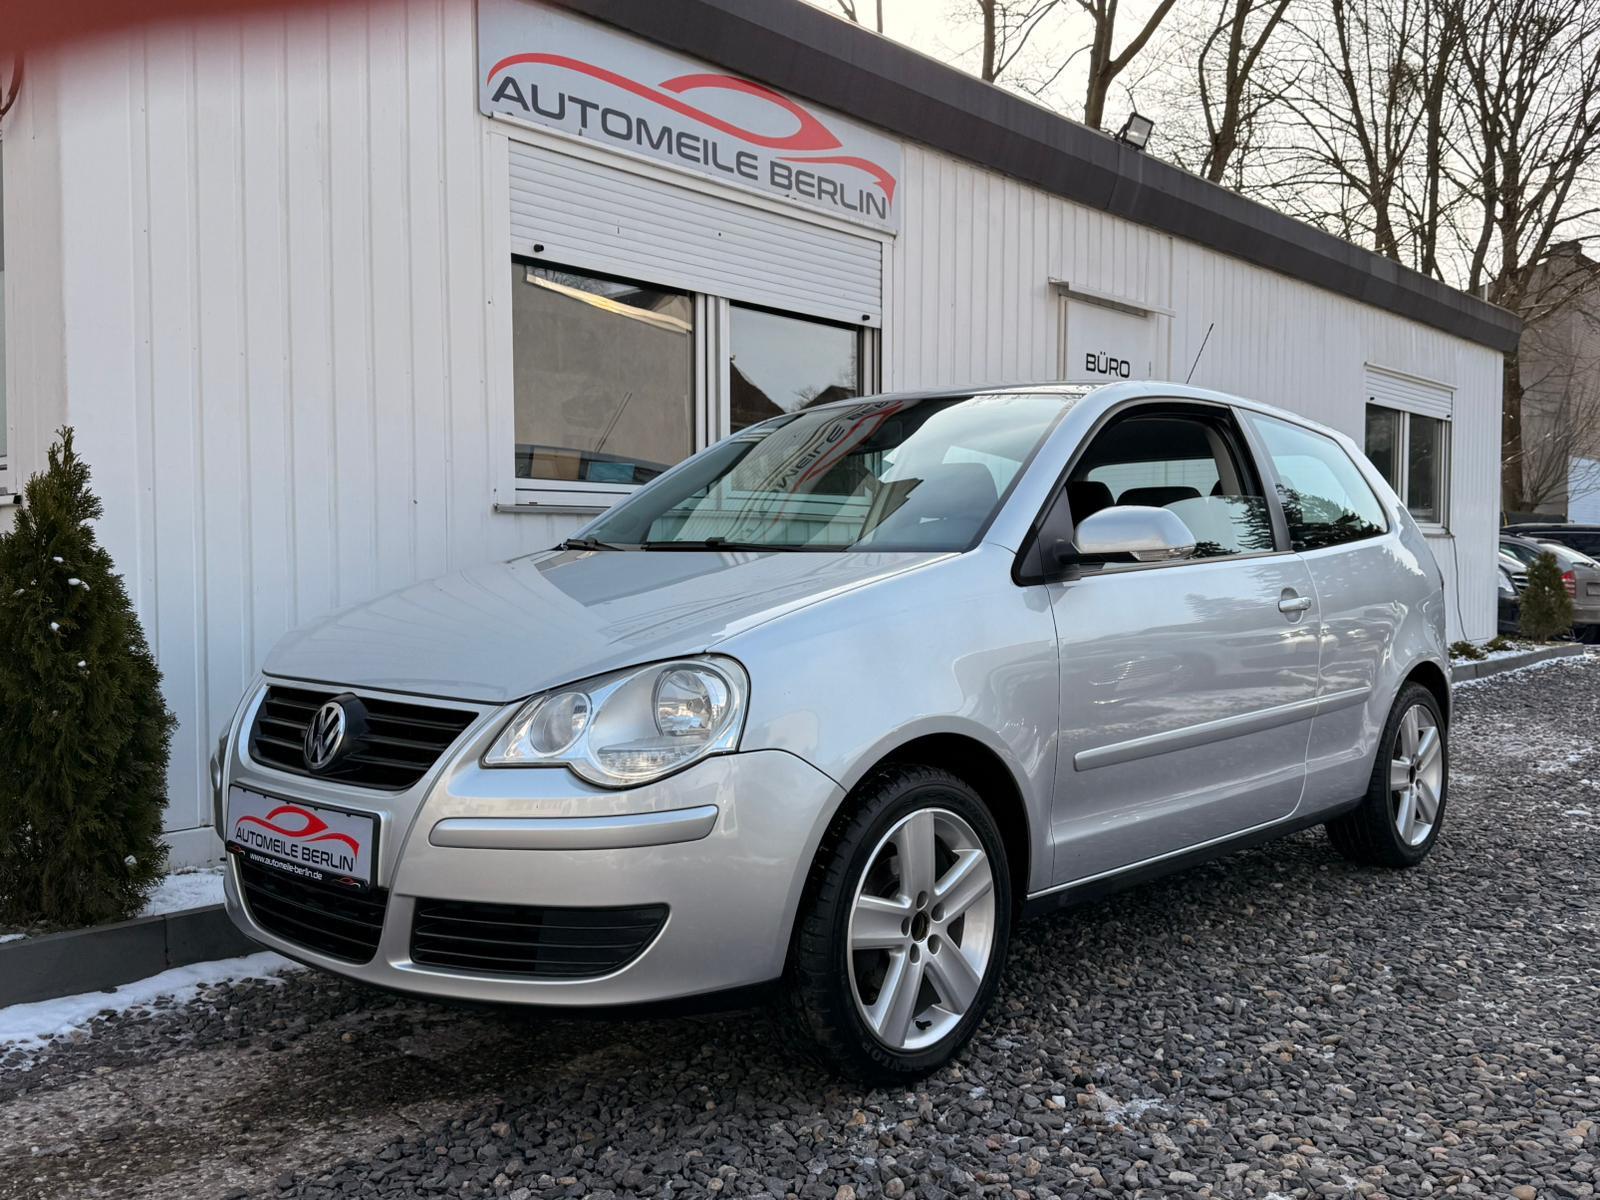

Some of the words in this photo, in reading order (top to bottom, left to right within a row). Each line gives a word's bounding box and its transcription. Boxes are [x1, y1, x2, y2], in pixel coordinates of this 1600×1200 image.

[491, 75, 759, 181] AUTOMEILE
[769, 159, 887, 220] BERLIN
[1085, 351, 1131, 378] BÜRO
[235, 827, 299, 859] AUTOMEILE
[301, 846, 354, 872] BERLIN
